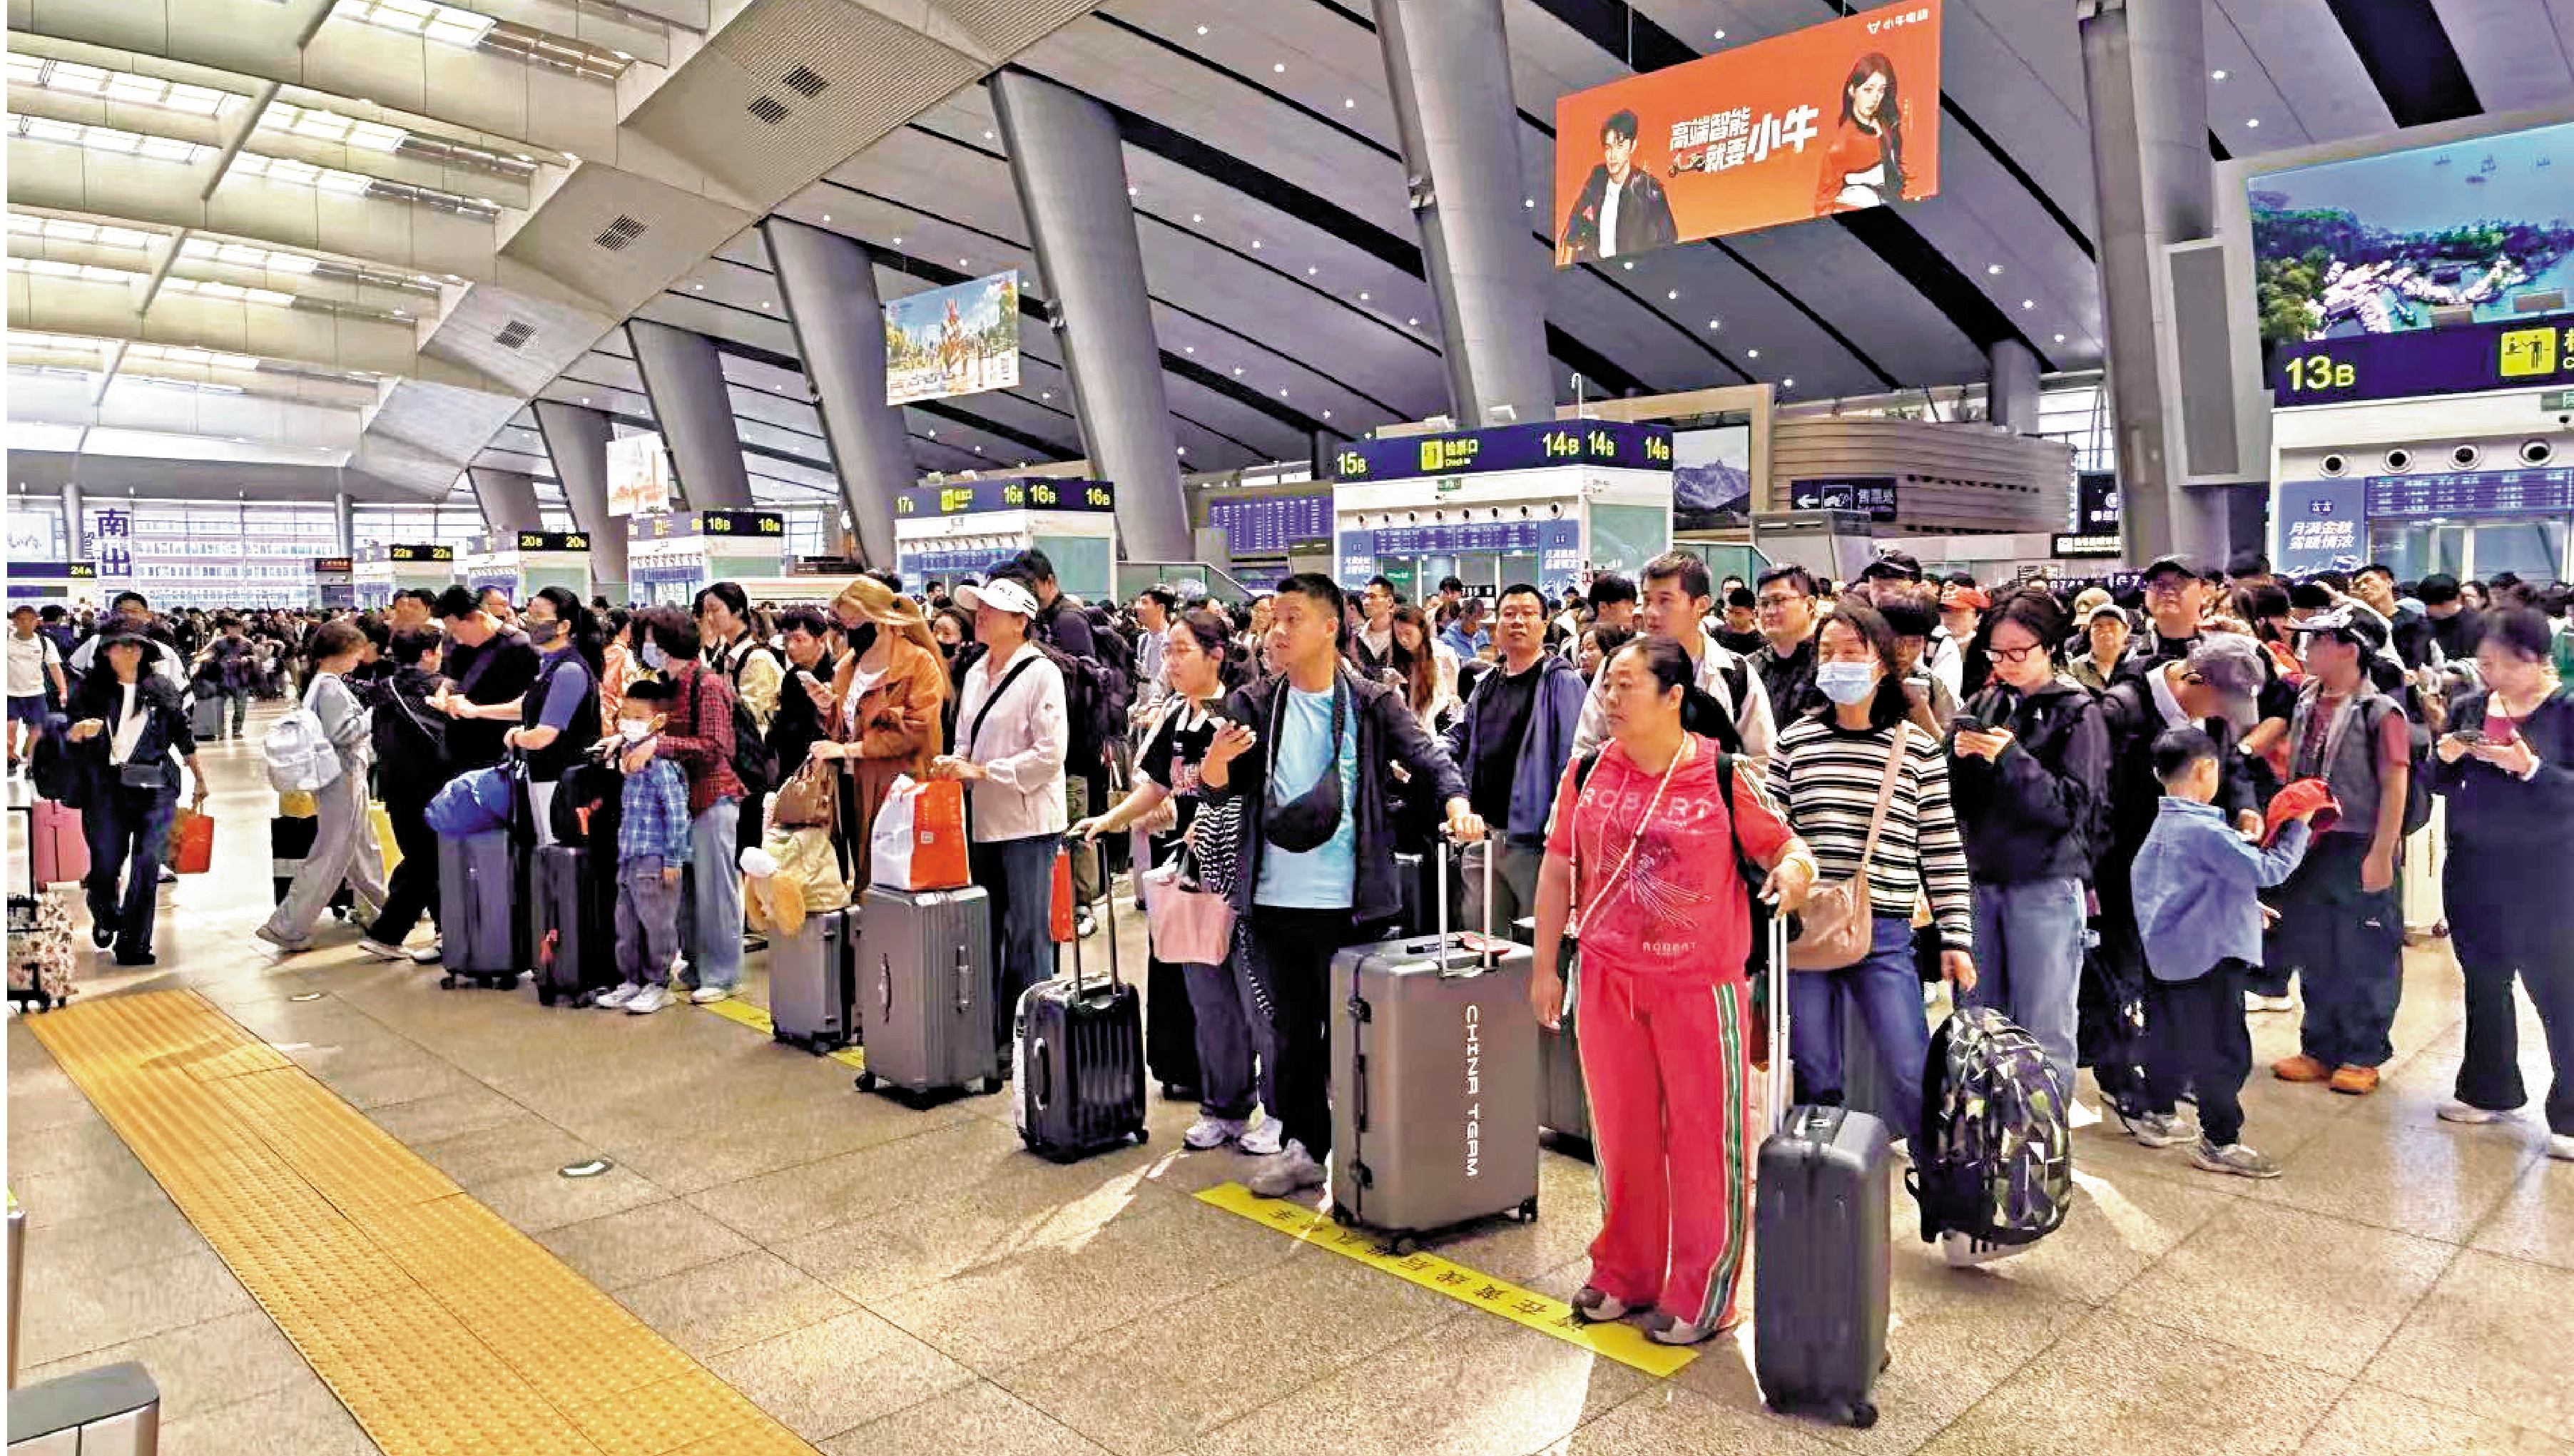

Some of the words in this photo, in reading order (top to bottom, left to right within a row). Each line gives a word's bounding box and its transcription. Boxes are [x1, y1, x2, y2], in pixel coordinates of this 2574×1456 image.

[1670, 107, 1751, 151] 高端智能
[1704, 137, 1748, 173] 就要
[1747, 105, 1818, 163] 小牛
[2286, 355, 2354, 390] 13B
[1543, 431, 1580, 457] 14B
[1588, 431, 1614, 457] 14B
[1645, 437, 1669, 459] 14B
[1337, 452, 1366, 474] 15B
[1003, 484, 1023, 504] 16B
[1029, 484, 1056, 503] 16B
[1085, 488, 1109, 506] 16B
[708, 516, 731, 531] 18B
[1580, 788, 1714, 819] ROBRT
[1467, 1004, 1478, 1094] CHINA
[1467, 1103, 1478, 1176] TEAM
